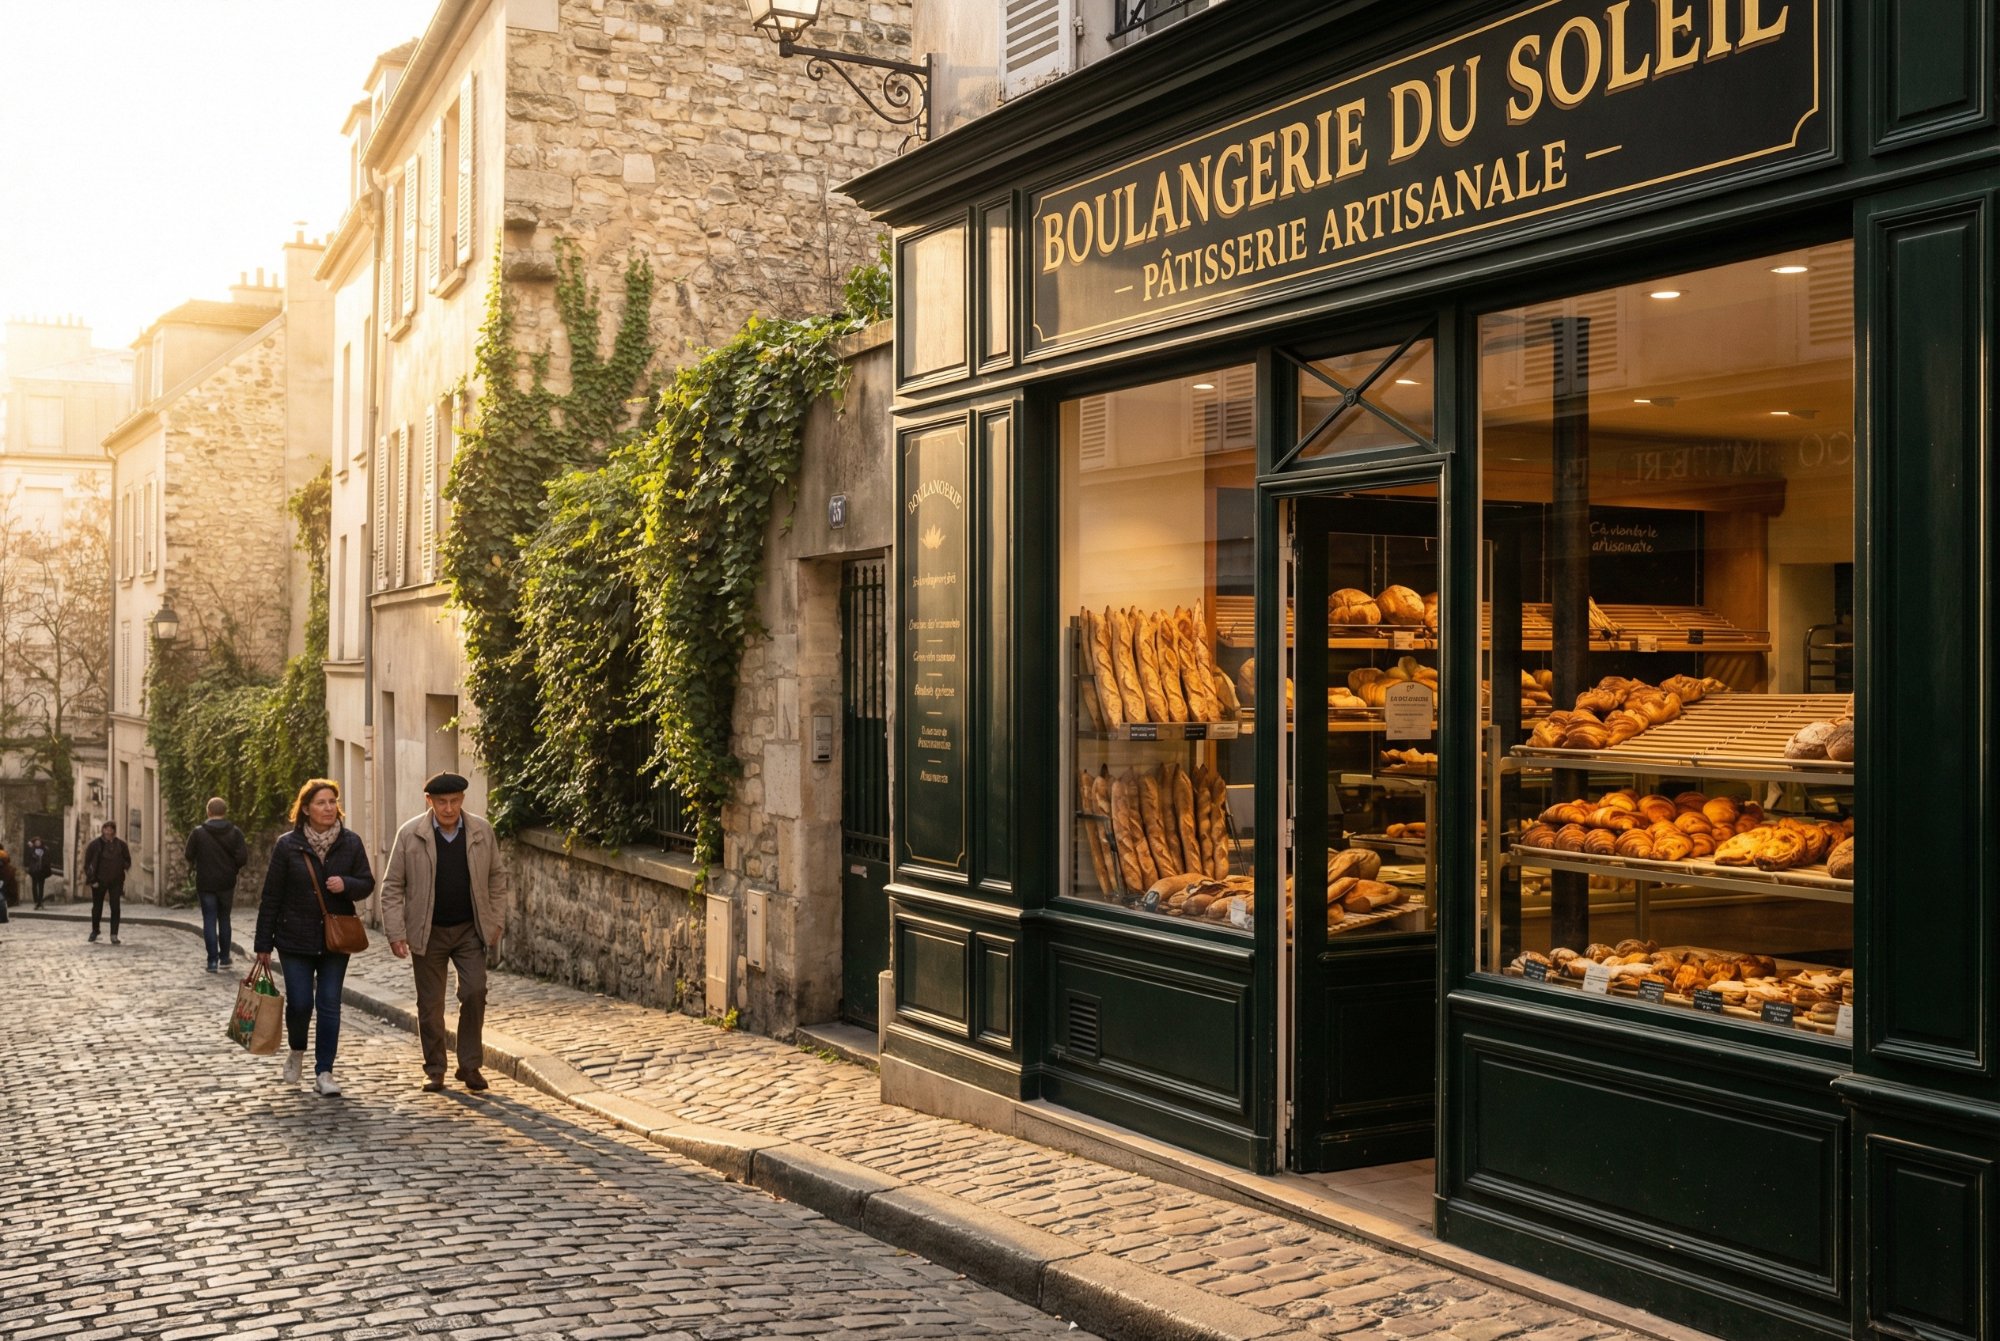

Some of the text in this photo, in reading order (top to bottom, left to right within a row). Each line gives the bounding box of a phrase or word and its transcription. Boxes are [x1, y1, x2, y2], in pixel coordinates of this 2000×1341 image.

[1042, 0, 1789, 276] BOULANGERIE DU SOLEIL
[1142, 139, 1568, 302] PÂTISSERIE ARTISANALE
